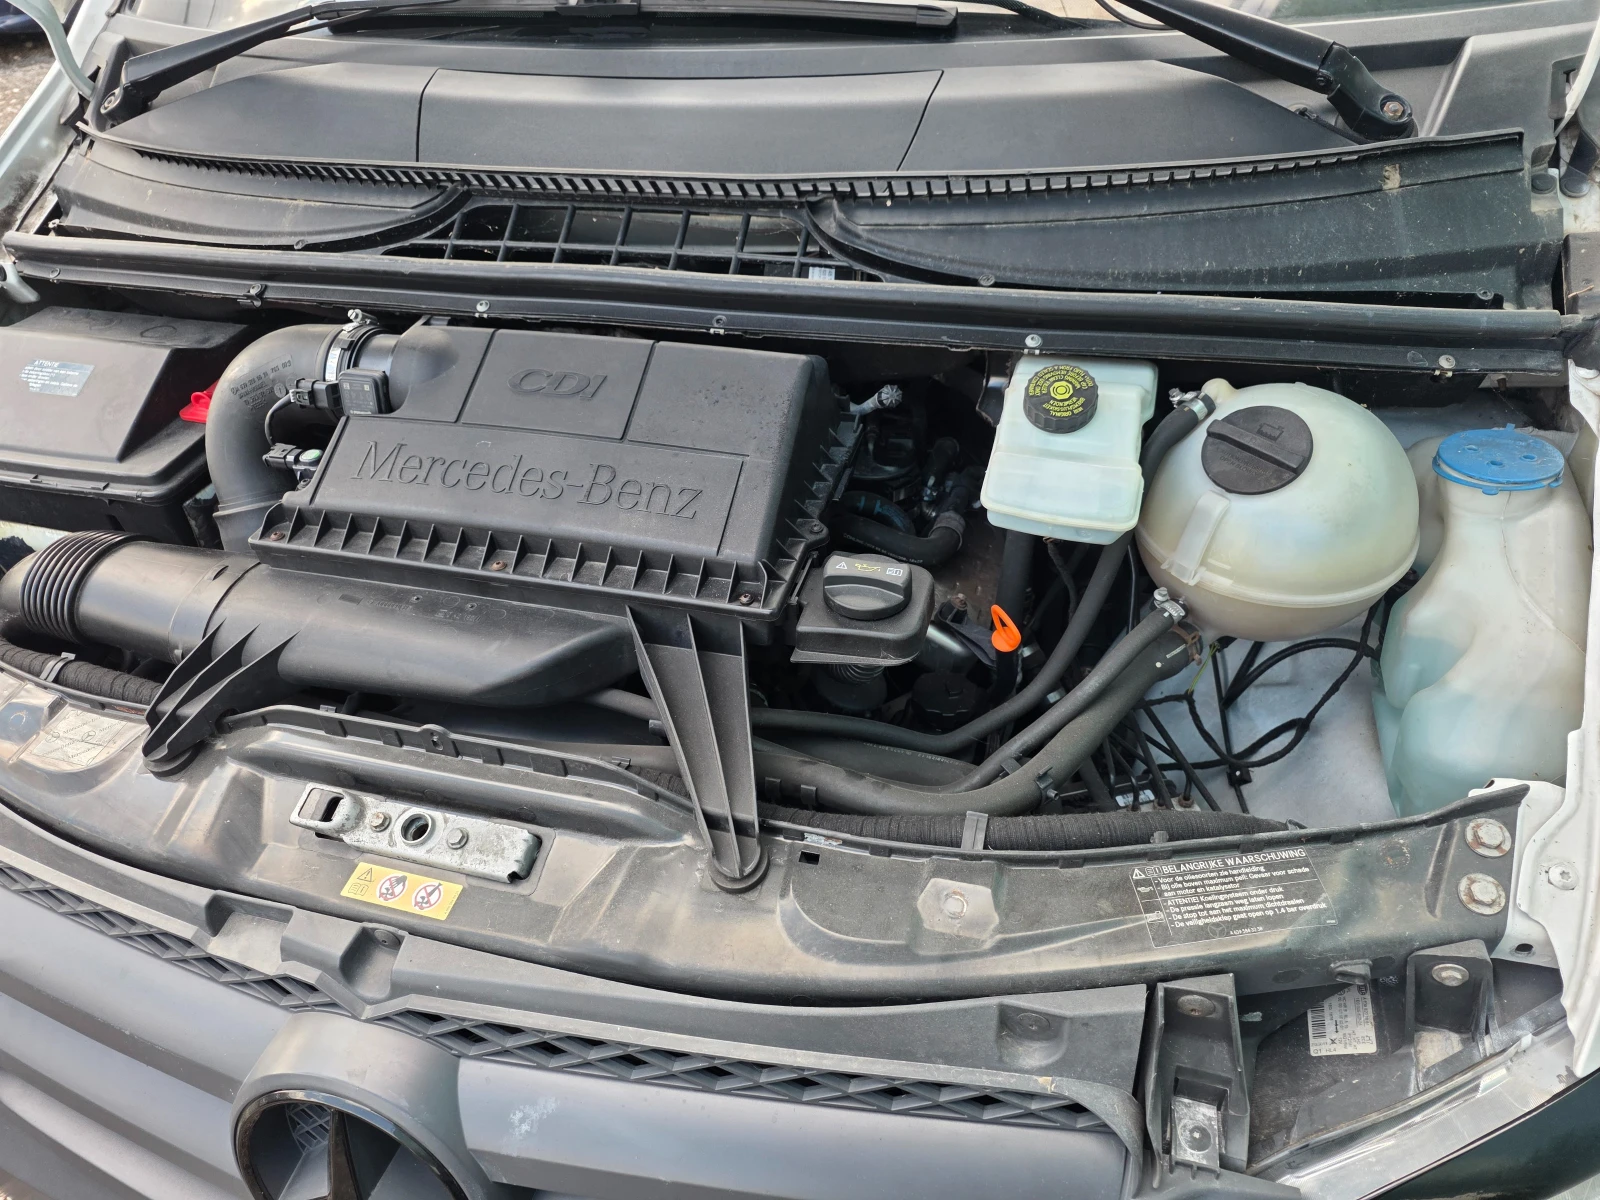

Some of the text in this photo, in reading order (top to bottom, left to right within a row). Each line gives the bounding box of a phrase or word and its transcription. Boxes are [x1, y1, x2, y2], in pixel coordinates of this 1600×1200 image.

[507, 368, 608, 400] CDI
[350, 440, 703, 520] Mercedes-Benz
[1162, 849, 1306, 874] BELANGRIJKE WAARSCHUWING
[1184, 871, 1218, 880] oliesoorten
[1203, 877, 1233, 885] maximum
[1249, 871, 1270, 879] Gevaar
[1180, 904, 1203, 912] pressie
[1203, 900, 1234, 909] langzaam
[1265, 894, 1284, 902] lopen
[1200, 890, 1249, 902] Koelingsysteem
[1233, 903, 1264, 912] maximum
[1185, 915, 1232, 927] veiligheidsklep
[1248, 910, 1264, 918] open
[1265, 909, 1274, 917] op
